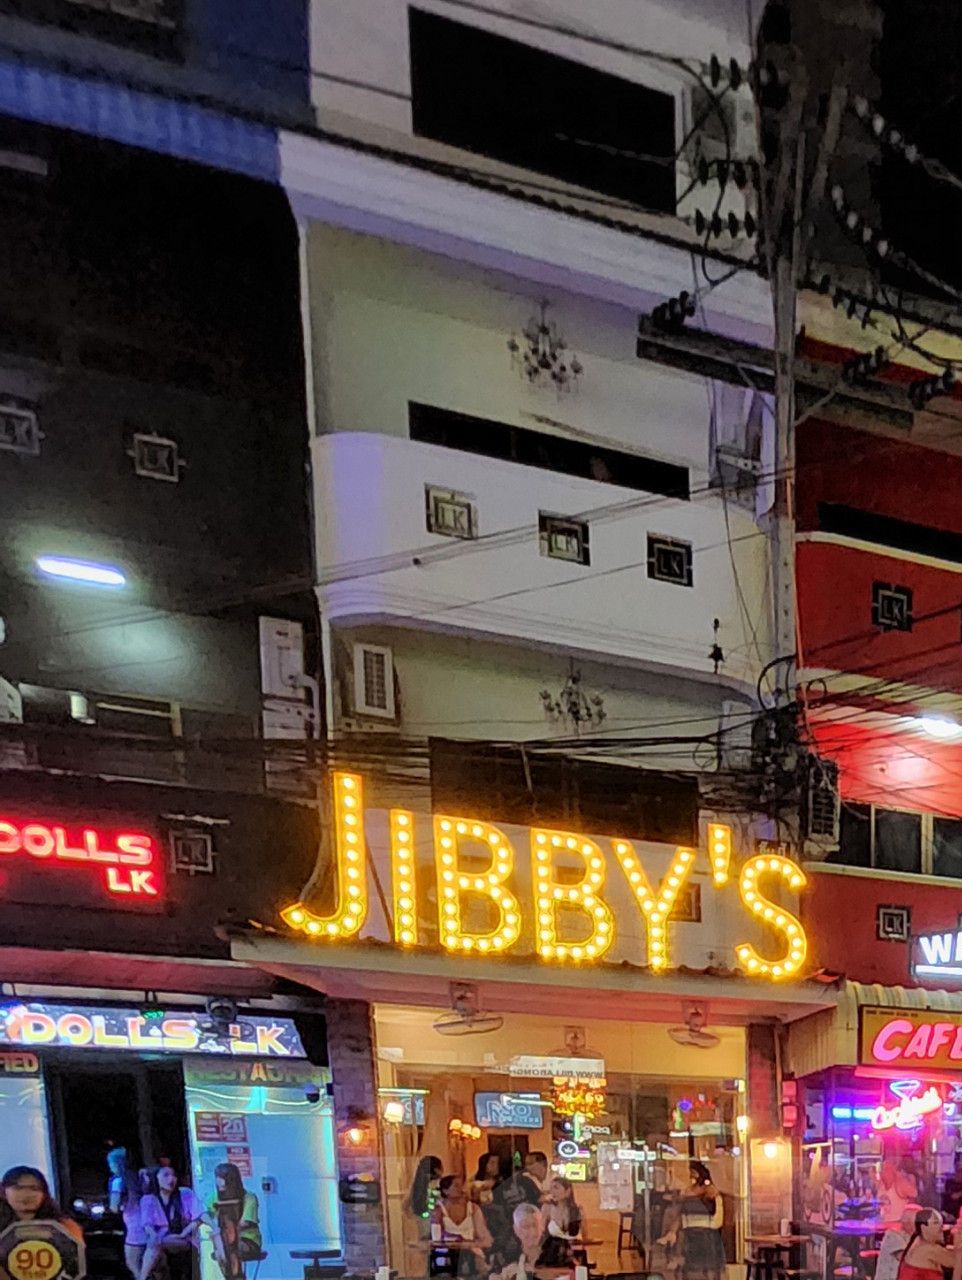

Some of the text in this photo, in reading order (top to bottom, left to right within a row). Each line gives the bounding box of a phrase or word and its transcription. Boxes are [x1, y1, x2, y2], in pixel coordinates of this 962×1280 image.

[107, 867, 158, 895] LK
[280, 771, 808, 981] JIBBY'S
[21, 1011, 200, 1049] DOLLS
[15, 1248, 54, 1270] 90
